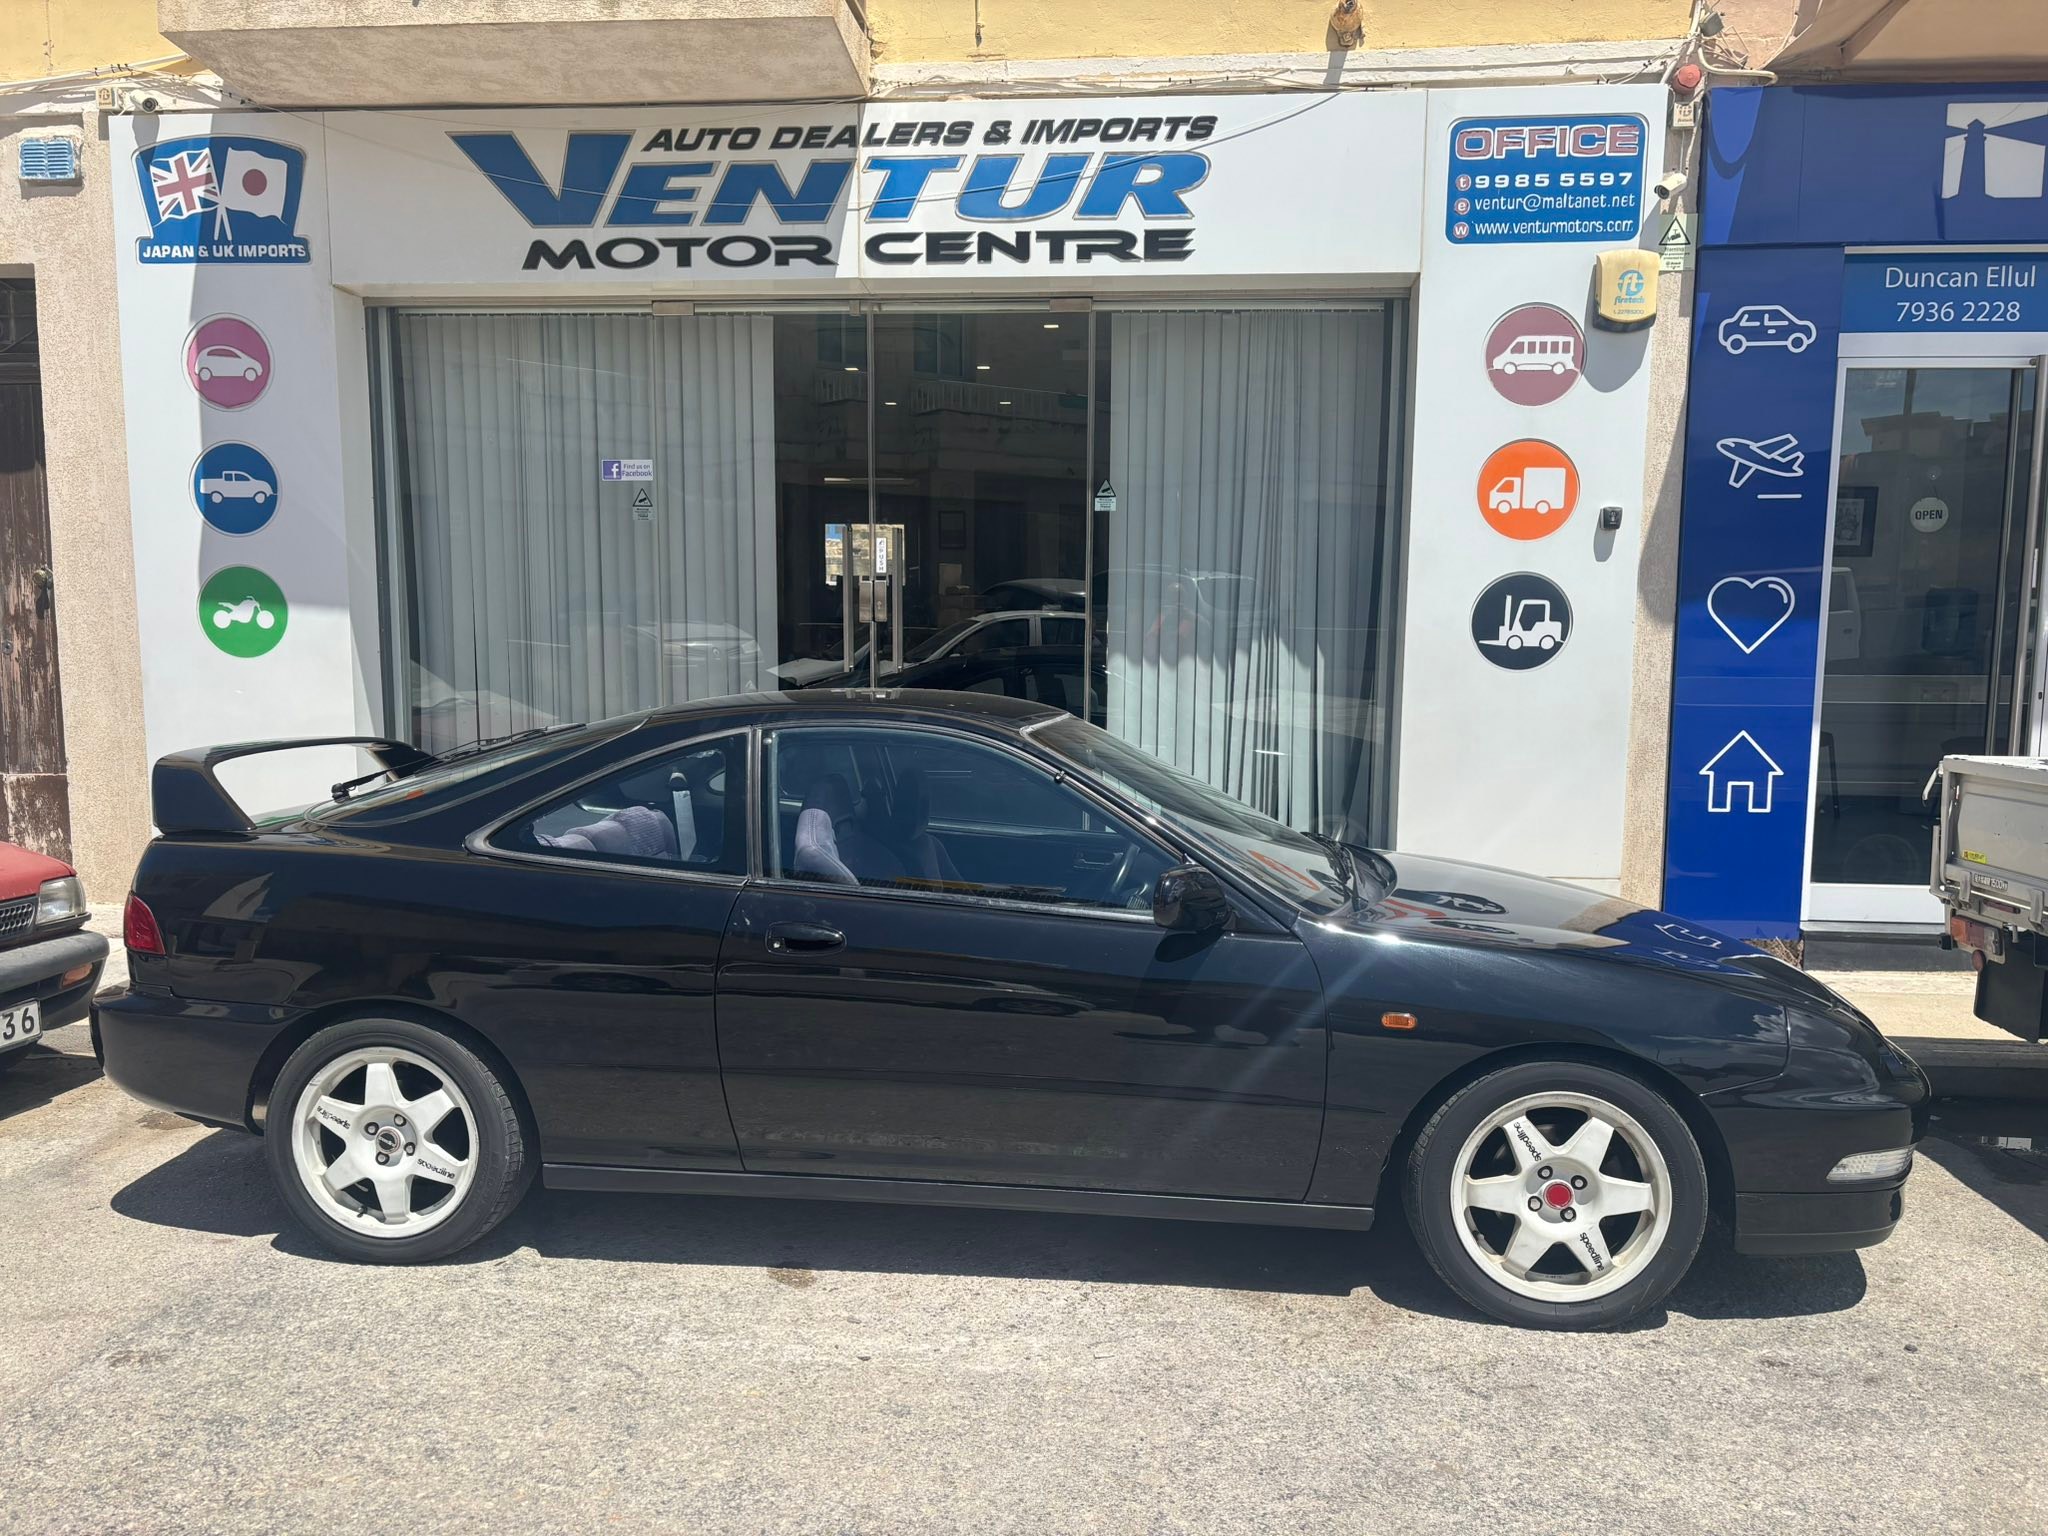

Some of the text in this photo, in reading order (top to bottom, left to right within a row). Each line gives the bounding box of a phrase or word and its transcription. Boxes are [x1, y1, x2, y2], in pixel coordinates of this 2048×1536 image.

[640, 115, 1218, 153] AUTO DEALERS & IMPORTS
[1455, 124, 1640, 160] OFFICE
[444, 131, 1213, 229] VENTUR
[1475, 173, 1550, 189] 9985
[1560, 172, 1633, 187] 5597
[1475, 193, 1636, 212] ventur@maltanet.net
[1475, 219, 1635, 236] www.venturmotors.com
[142, 243, 306, 258] JAPAN & UK IMPORTS
[521, 227, 1197, 271] MOTOR CENTRE
[1884, 265, 2036, 288] Duncan Ellul
[1896, 301, 2021, 322] 7936 2228
[1915, 509, 1943, 521] OPEN
[2, 1007, 36, 1040] 36
[1513, 1121, 1542, 1162] speedline
[1579, 1231, 1605, 1271] speedline
